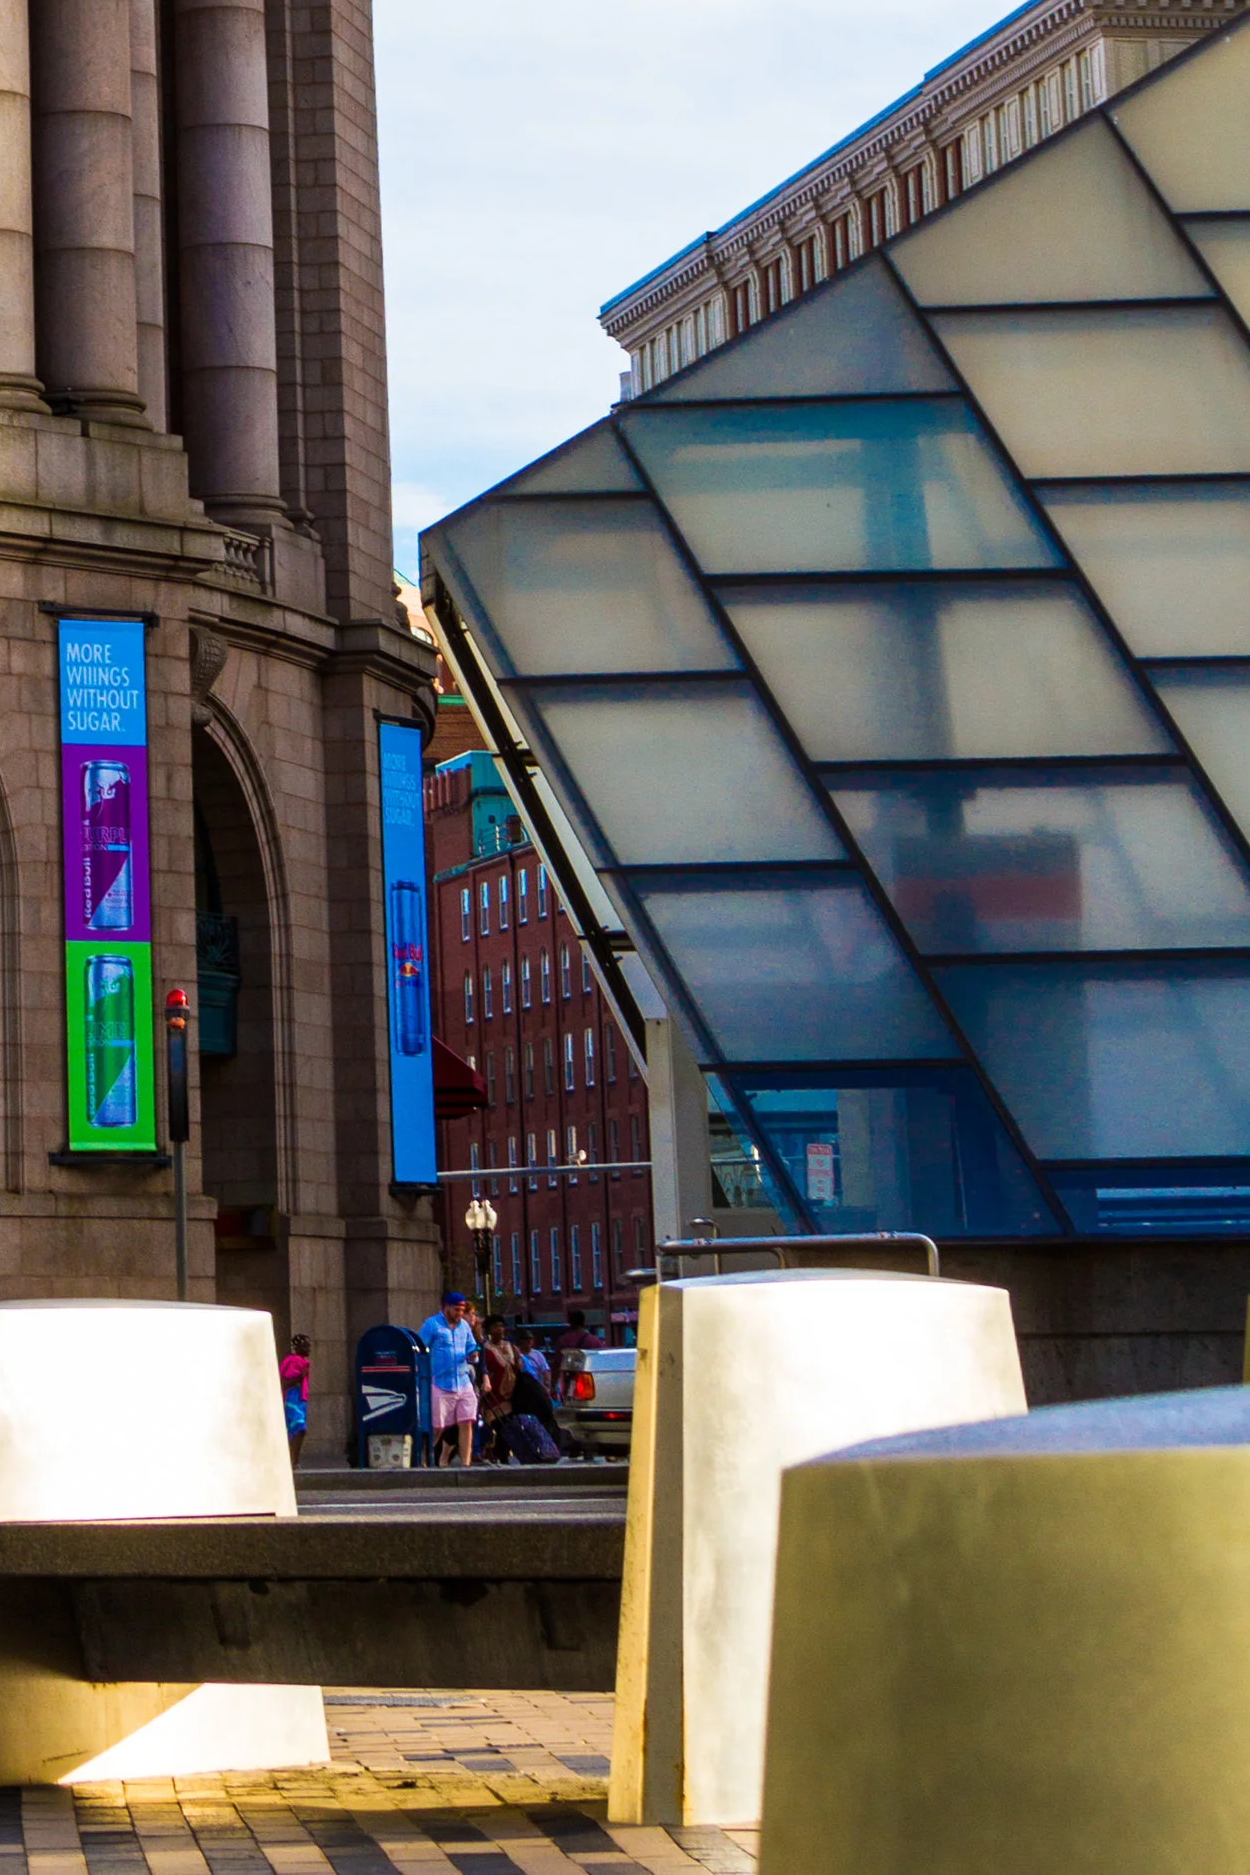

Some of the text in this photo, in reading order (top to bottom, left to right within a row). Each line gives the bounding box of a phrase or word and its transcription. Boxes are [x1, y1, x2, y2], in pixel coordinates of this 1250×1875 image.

[66, 642, 111, 664] MORE
[67, 688, 139, 710] WITHOUT
[68, 711, 126, 732] SUGAR.
